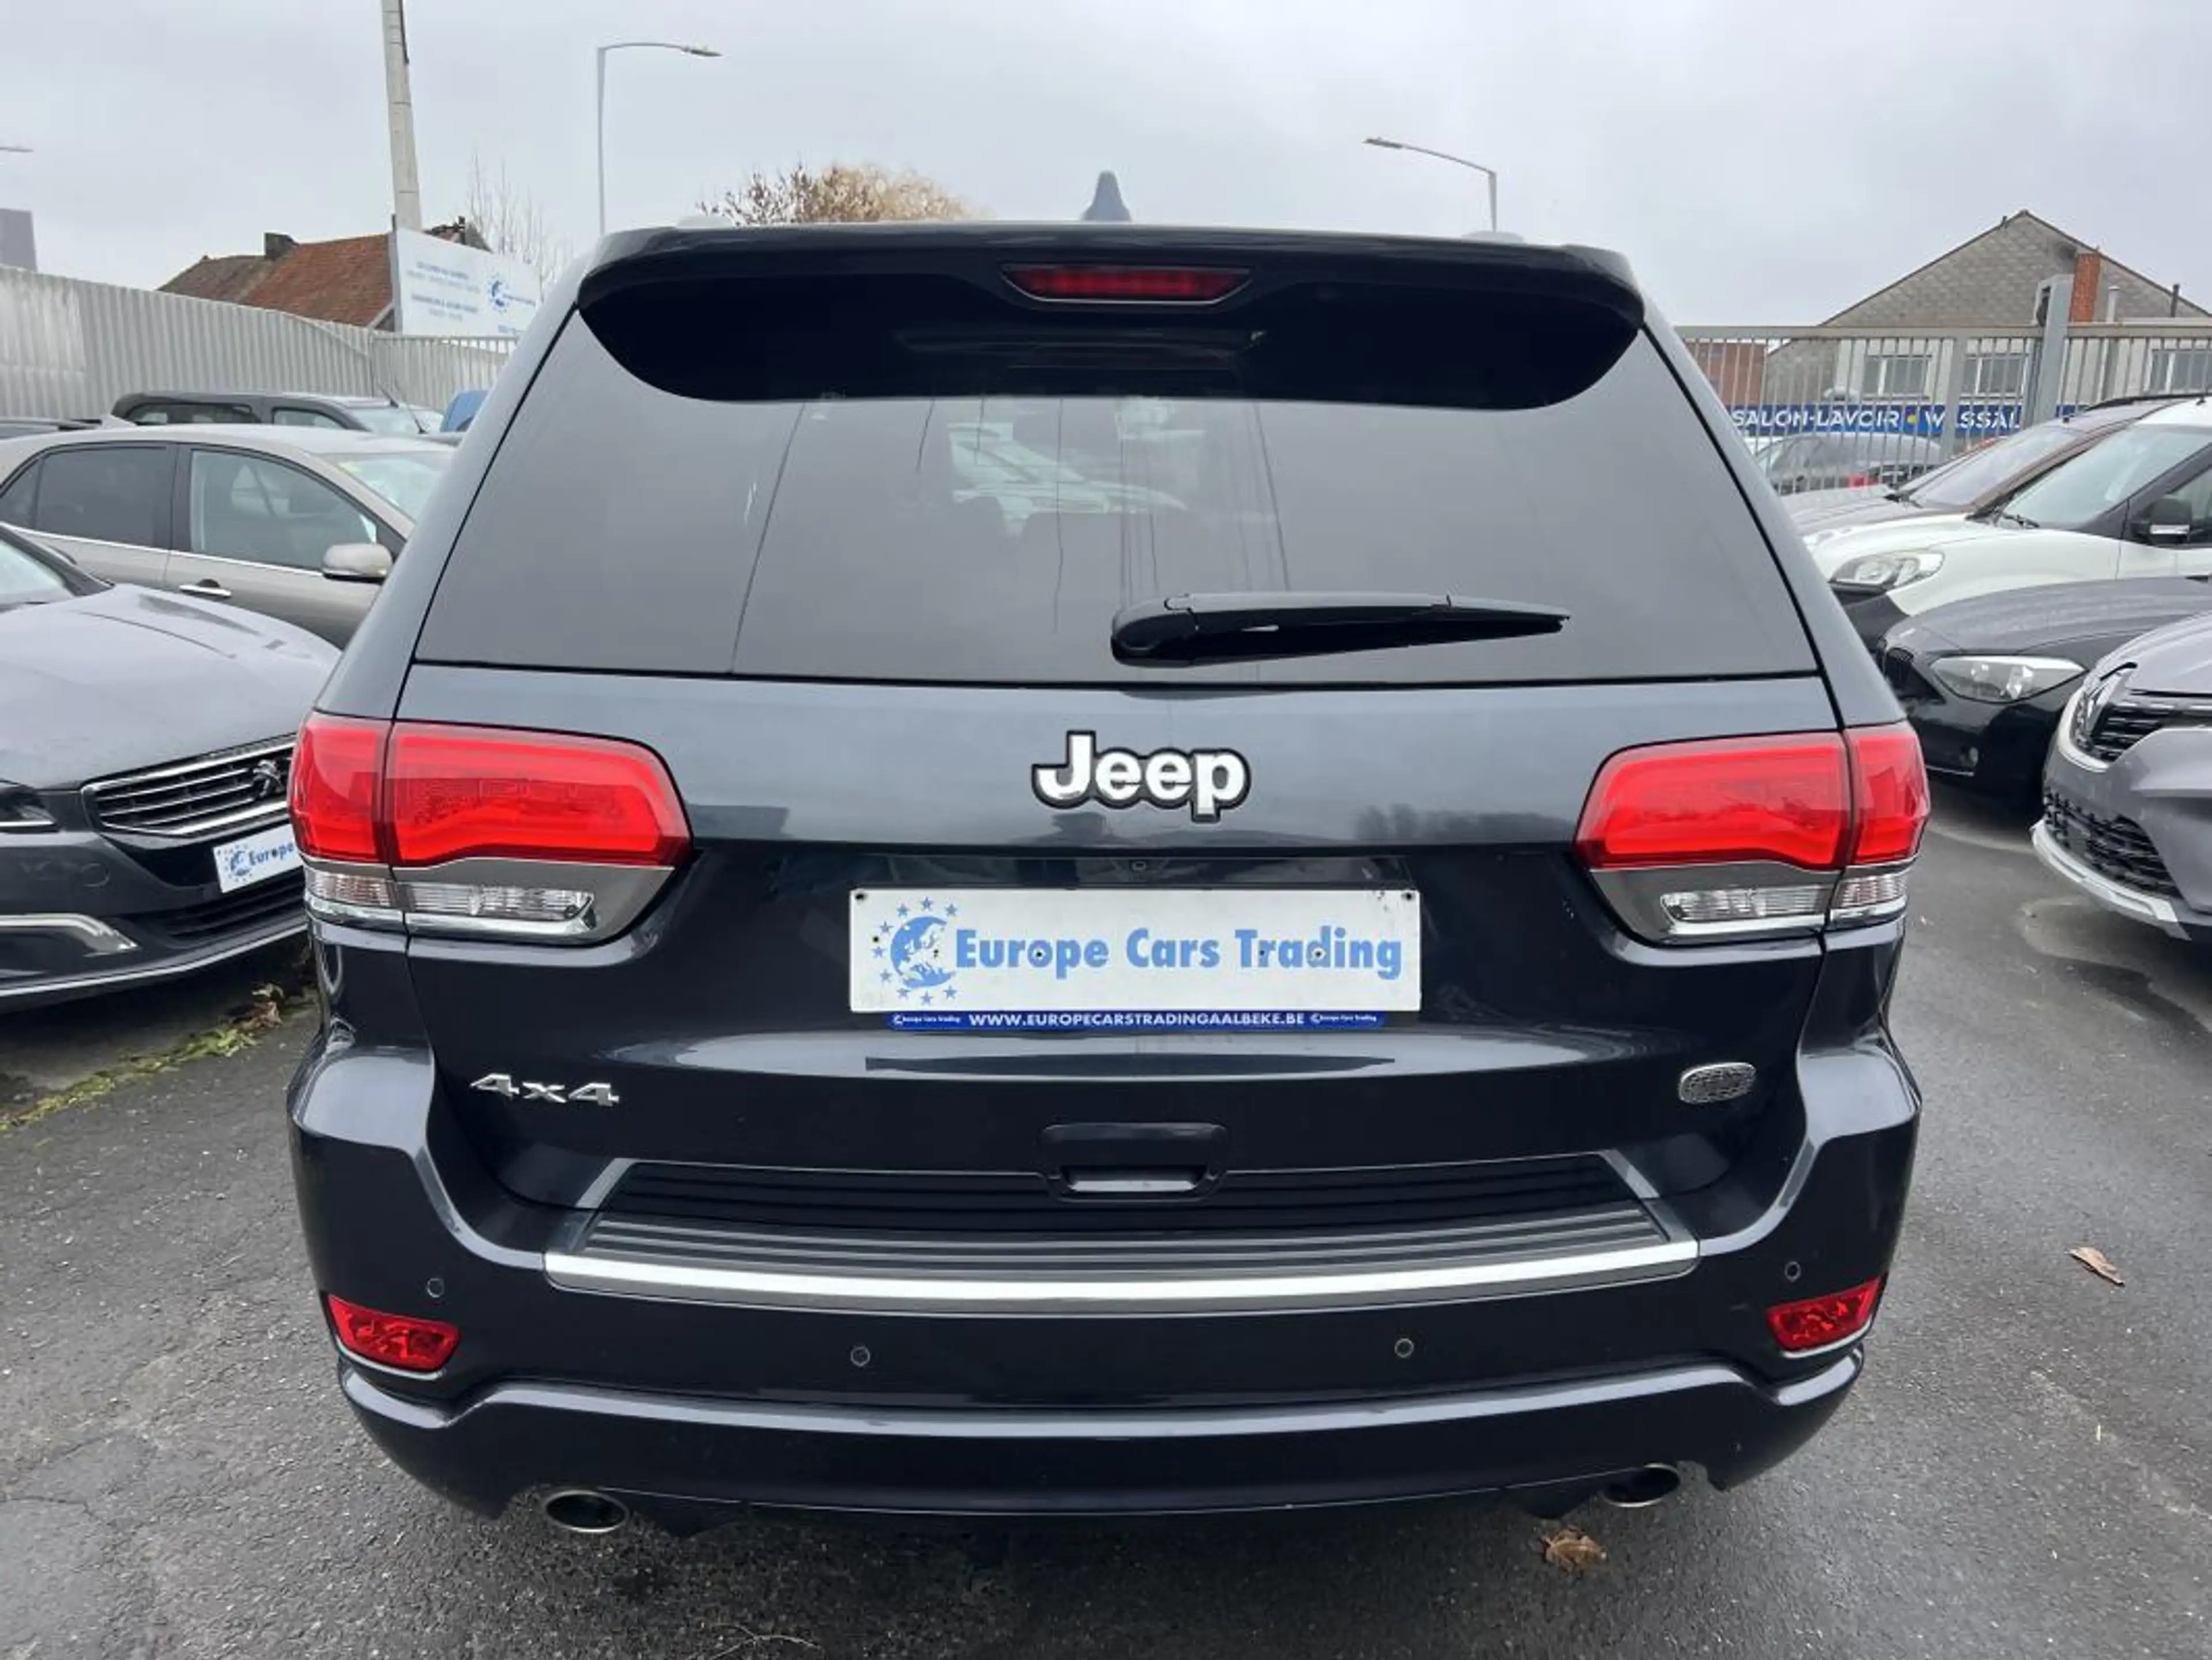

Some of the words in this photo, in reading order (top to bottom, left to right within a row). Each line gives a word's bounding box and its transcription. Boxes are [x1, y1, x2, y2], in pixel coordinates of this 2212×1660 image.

[1732, 409, 1901, 428] SALON-LAVOIR
[1925, 410, 2020, 428] WSSAL
[1032, 730, 1250, 822] Jeep
[248, 842, 295, 866] Europe
[956, 929, 1109, 980] Europe
[1125, 927, 1221, 968] Cars
[1234, 925, 1402, 980] Trading
[968, 1012, 1305, 1027] WWW.EUROPECARSTRADINGAALBEKE.BE
[470, 1073, 620, 1107] 4x4
